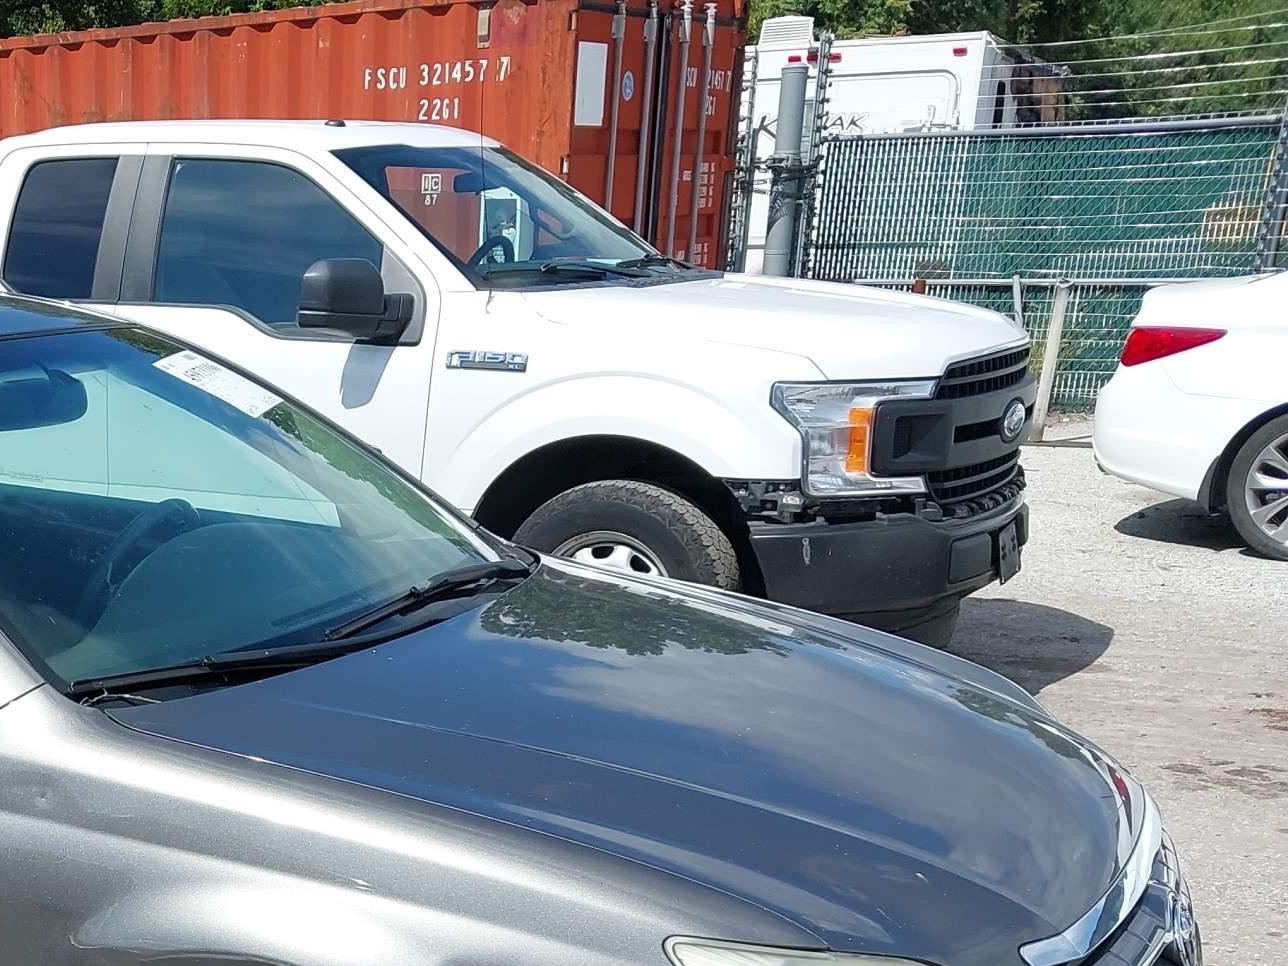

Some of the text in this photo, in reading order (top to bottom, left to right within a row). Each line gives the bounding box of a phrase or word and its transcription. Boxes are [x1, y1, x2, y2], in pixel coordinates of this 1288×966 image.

[364, 67, 407, 90] FSCU
[419, 60, 488, 86] 321457
[418, 97, 460, 121] 22G1
[425, 195, 438, 206] 87
